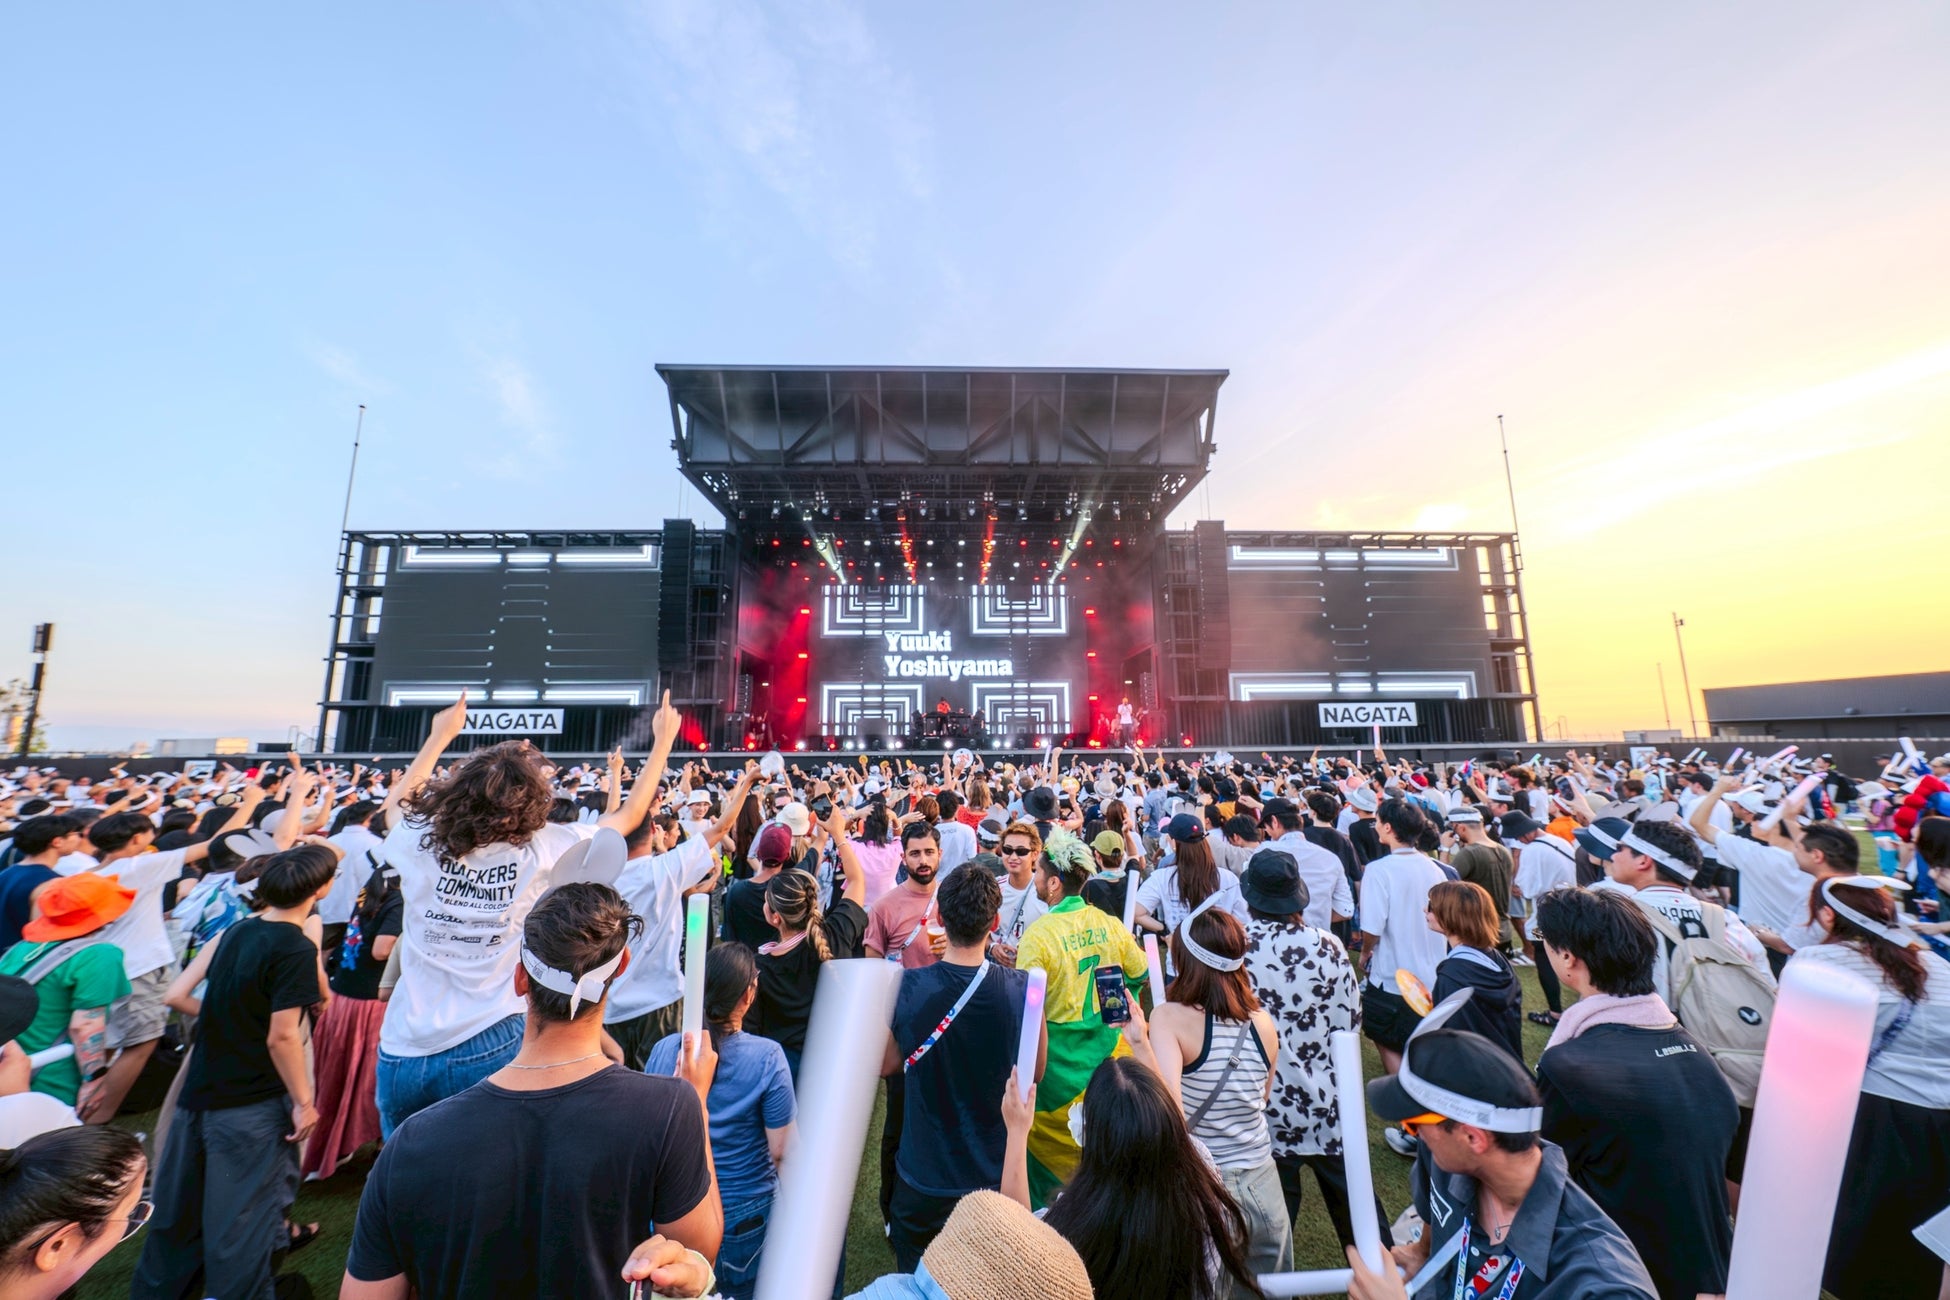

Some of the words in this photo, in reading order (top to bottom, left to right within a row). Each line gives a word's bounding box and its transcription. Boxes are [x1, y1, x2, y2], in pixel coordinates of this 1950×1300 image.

[884, 630, 952, 652] Yuuki
[884, 655, 1013, 682] Yoshiyama
[462, 712, 557, 730] NAGATA
[1323, 706, 1412, 723] NAGATA
[435, 876, 516, 902] COMMUNITY
[444, 898, 469, 908] BLEND
[469, 902, 482, 910] ALL
